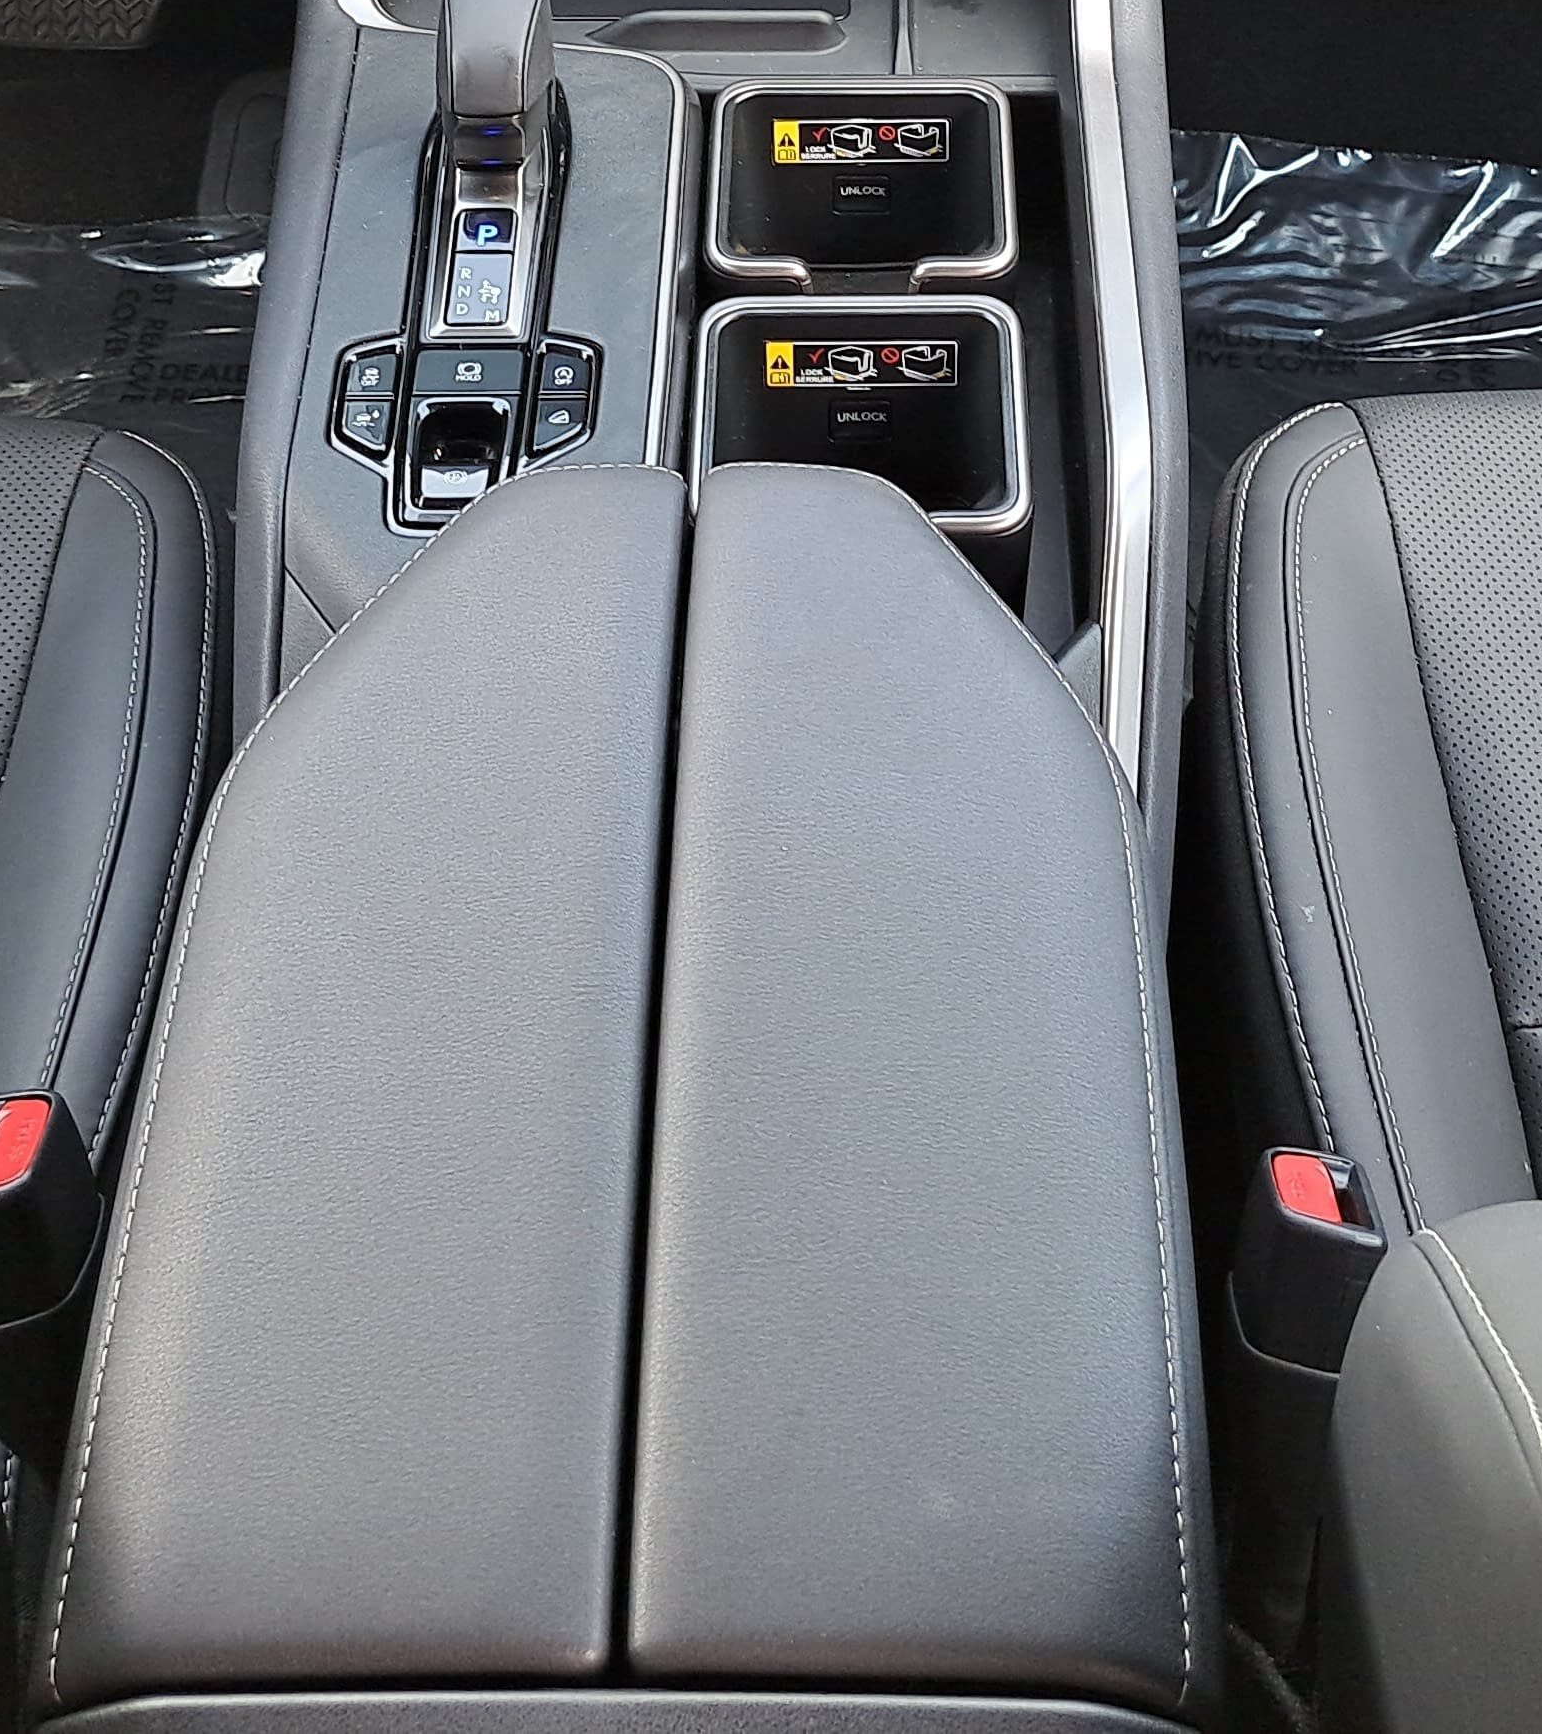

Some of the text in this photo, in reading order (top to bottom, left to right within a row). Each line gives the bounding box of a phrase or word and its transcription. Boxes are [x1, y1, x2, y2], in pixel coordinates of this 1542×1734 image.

[839, 186, 887, 197] UNLOCK
[475, 224, 498, 247] P
[460, 267, 472, 280] R
[458, 285, 471, 298] N
[456, 303, 469, 316] D
[485, 309, 501, 323] M
[837, 412, 888, 423] UNLOCK
